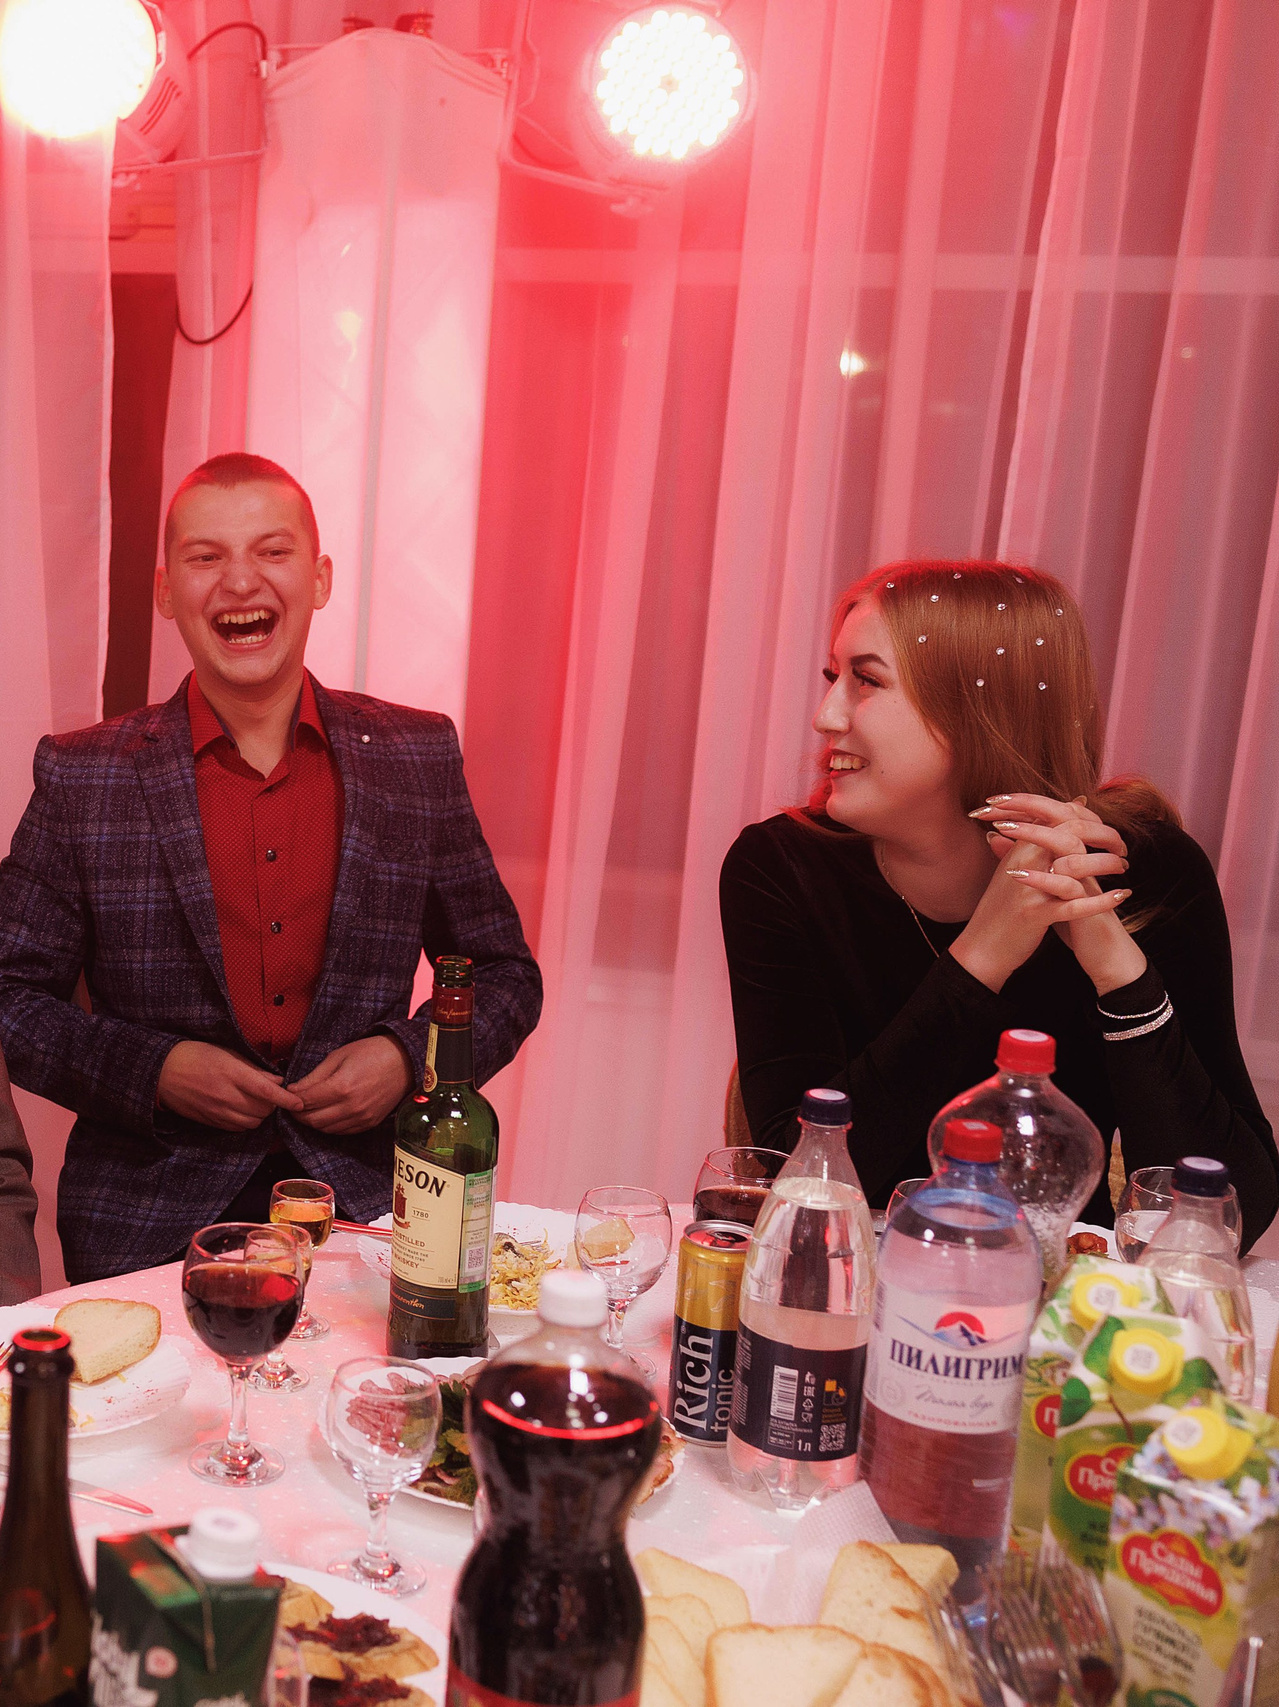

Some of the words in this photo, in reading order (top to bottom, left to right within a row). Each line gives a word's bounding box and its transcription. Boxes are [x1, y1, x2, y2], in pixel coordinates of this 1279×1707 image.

[395, 1156, 447, 1198] ESON
[413, 1209, 429, 1219] 1780
[673, 1335, 714, 1432] Rich
[710, 1369, 735, 1433] tonic
